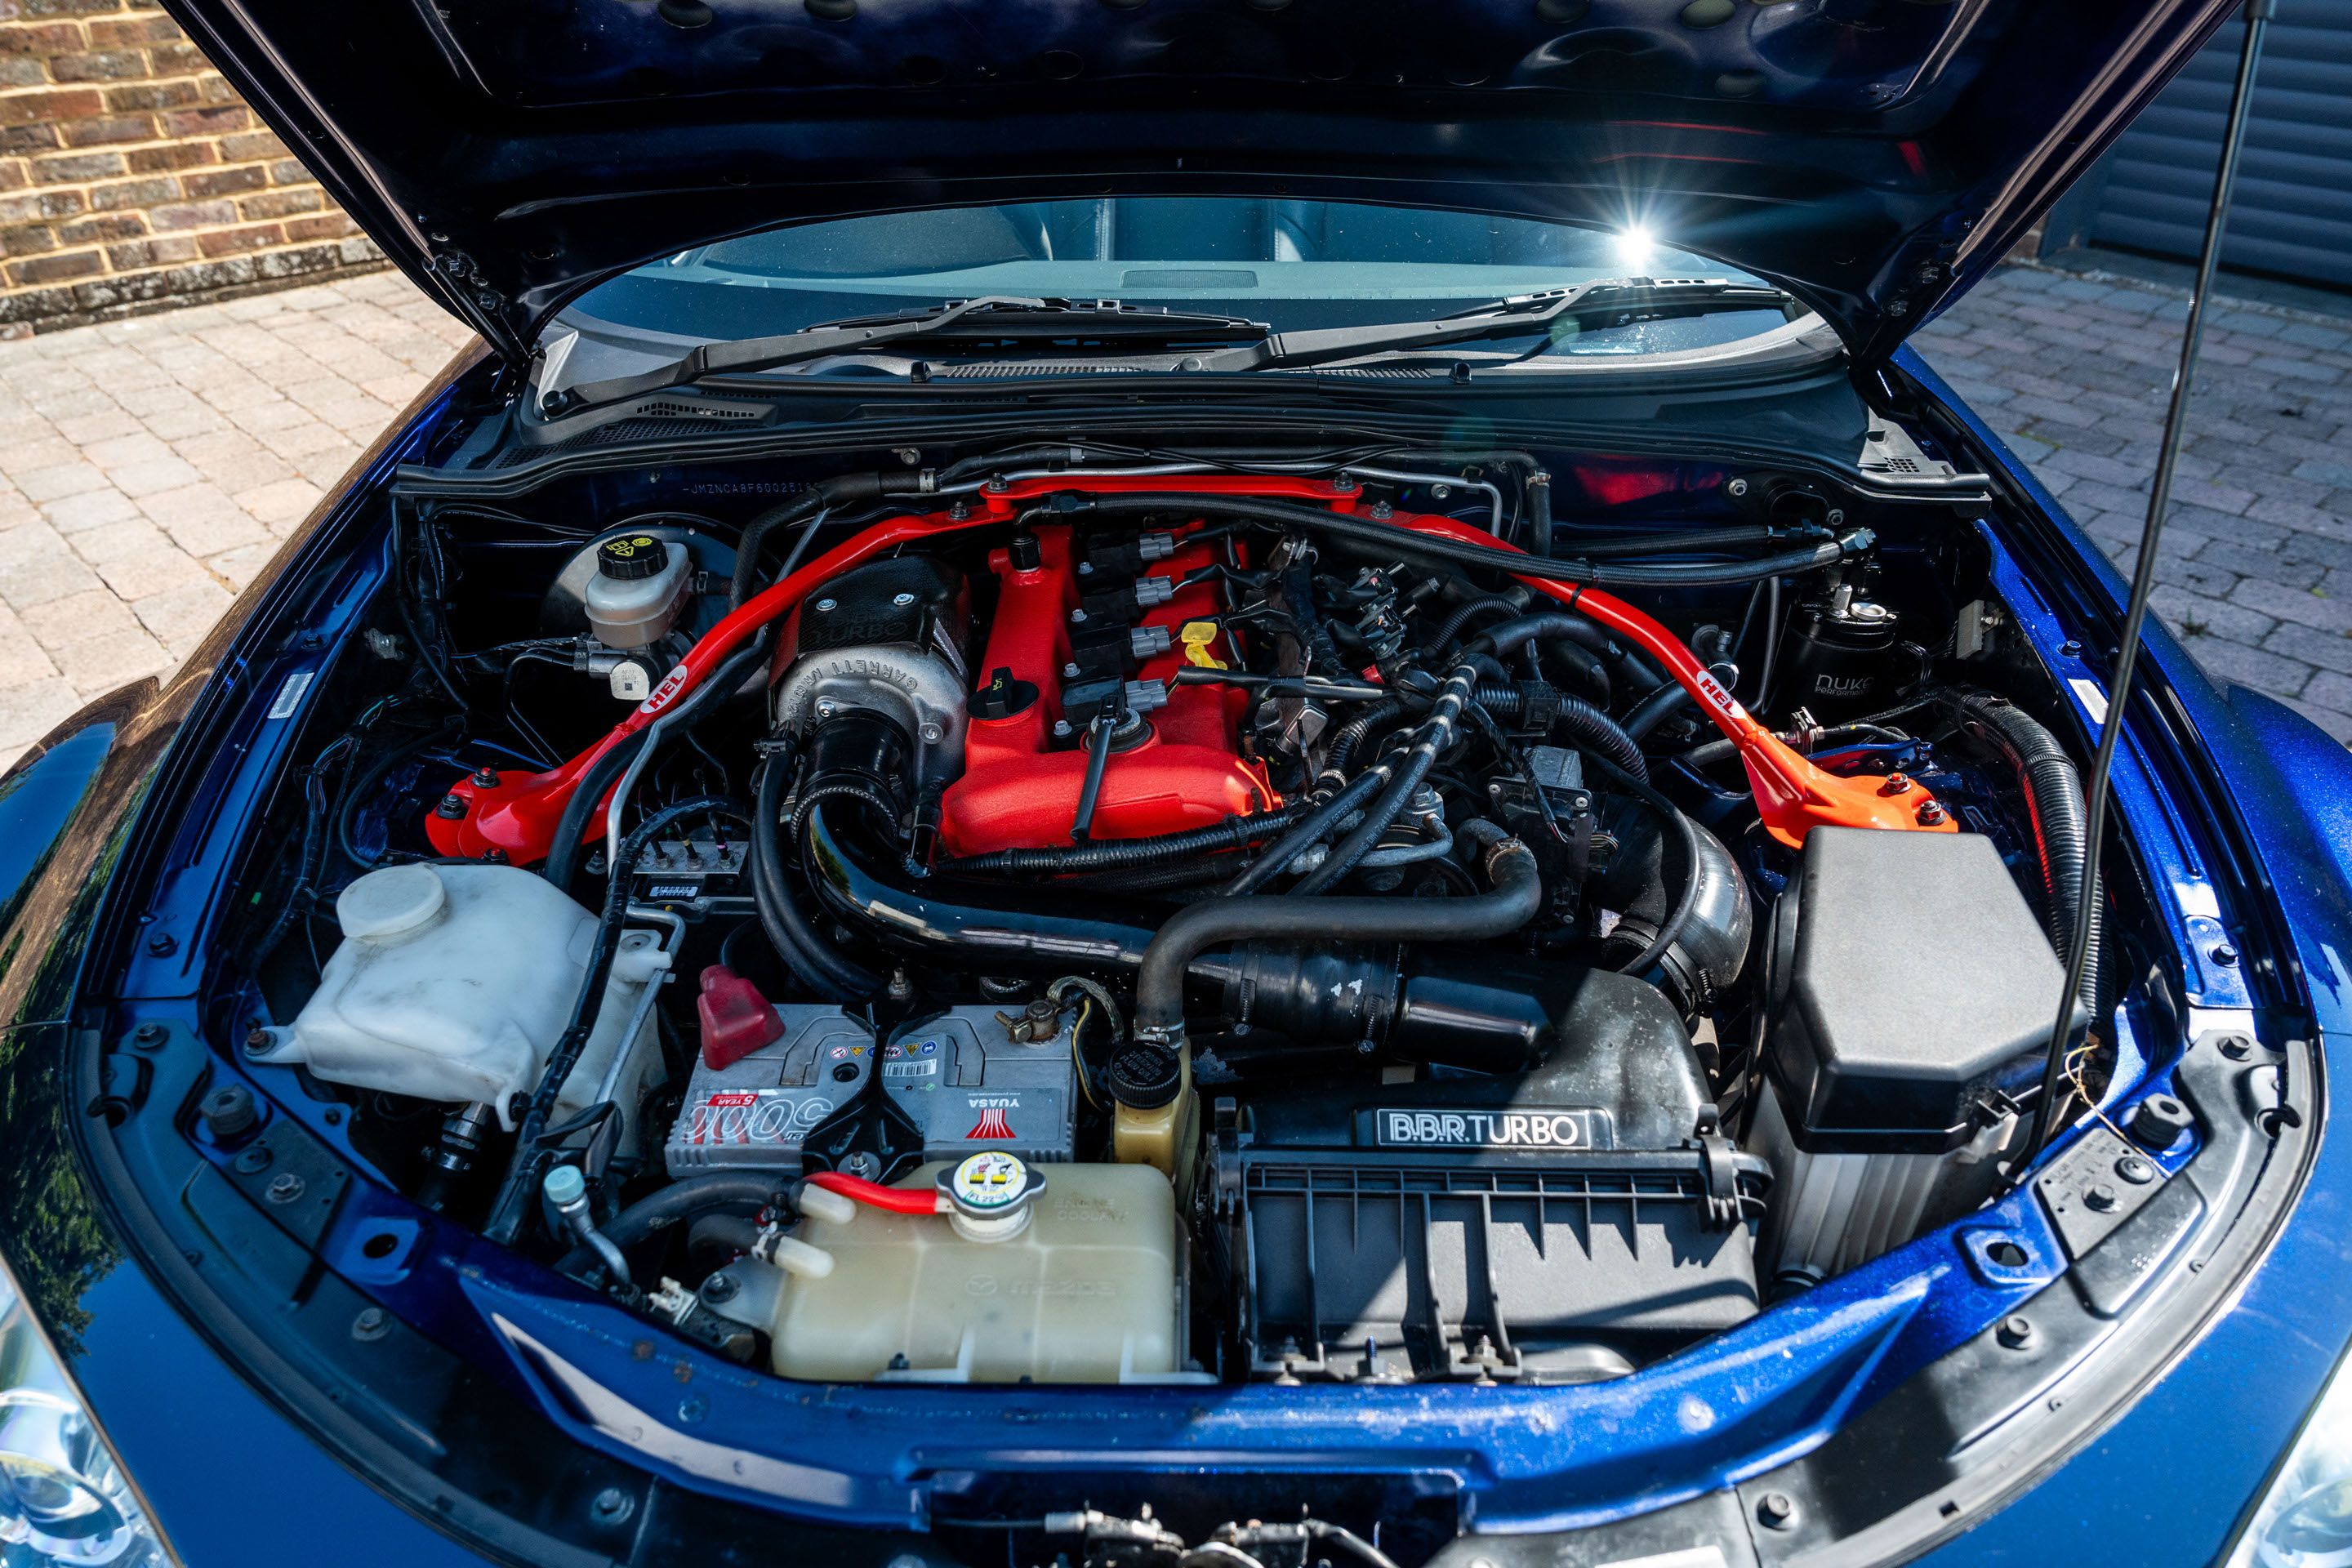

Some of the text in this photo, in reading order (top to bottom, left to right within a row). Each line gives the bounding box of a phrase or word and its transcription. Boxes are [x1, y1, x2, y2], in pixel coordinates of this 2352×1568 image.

[831, 660, 918, 690] GARRETT
[648, 675, 684, 710] HEL
[1700, 678, 1734, 715] HEL
[1815, 686, 1865, 697] PERFORMAN
[743, 1095, 754, 1105] 5
[969, 1098, 1020, 1108] YUASA
